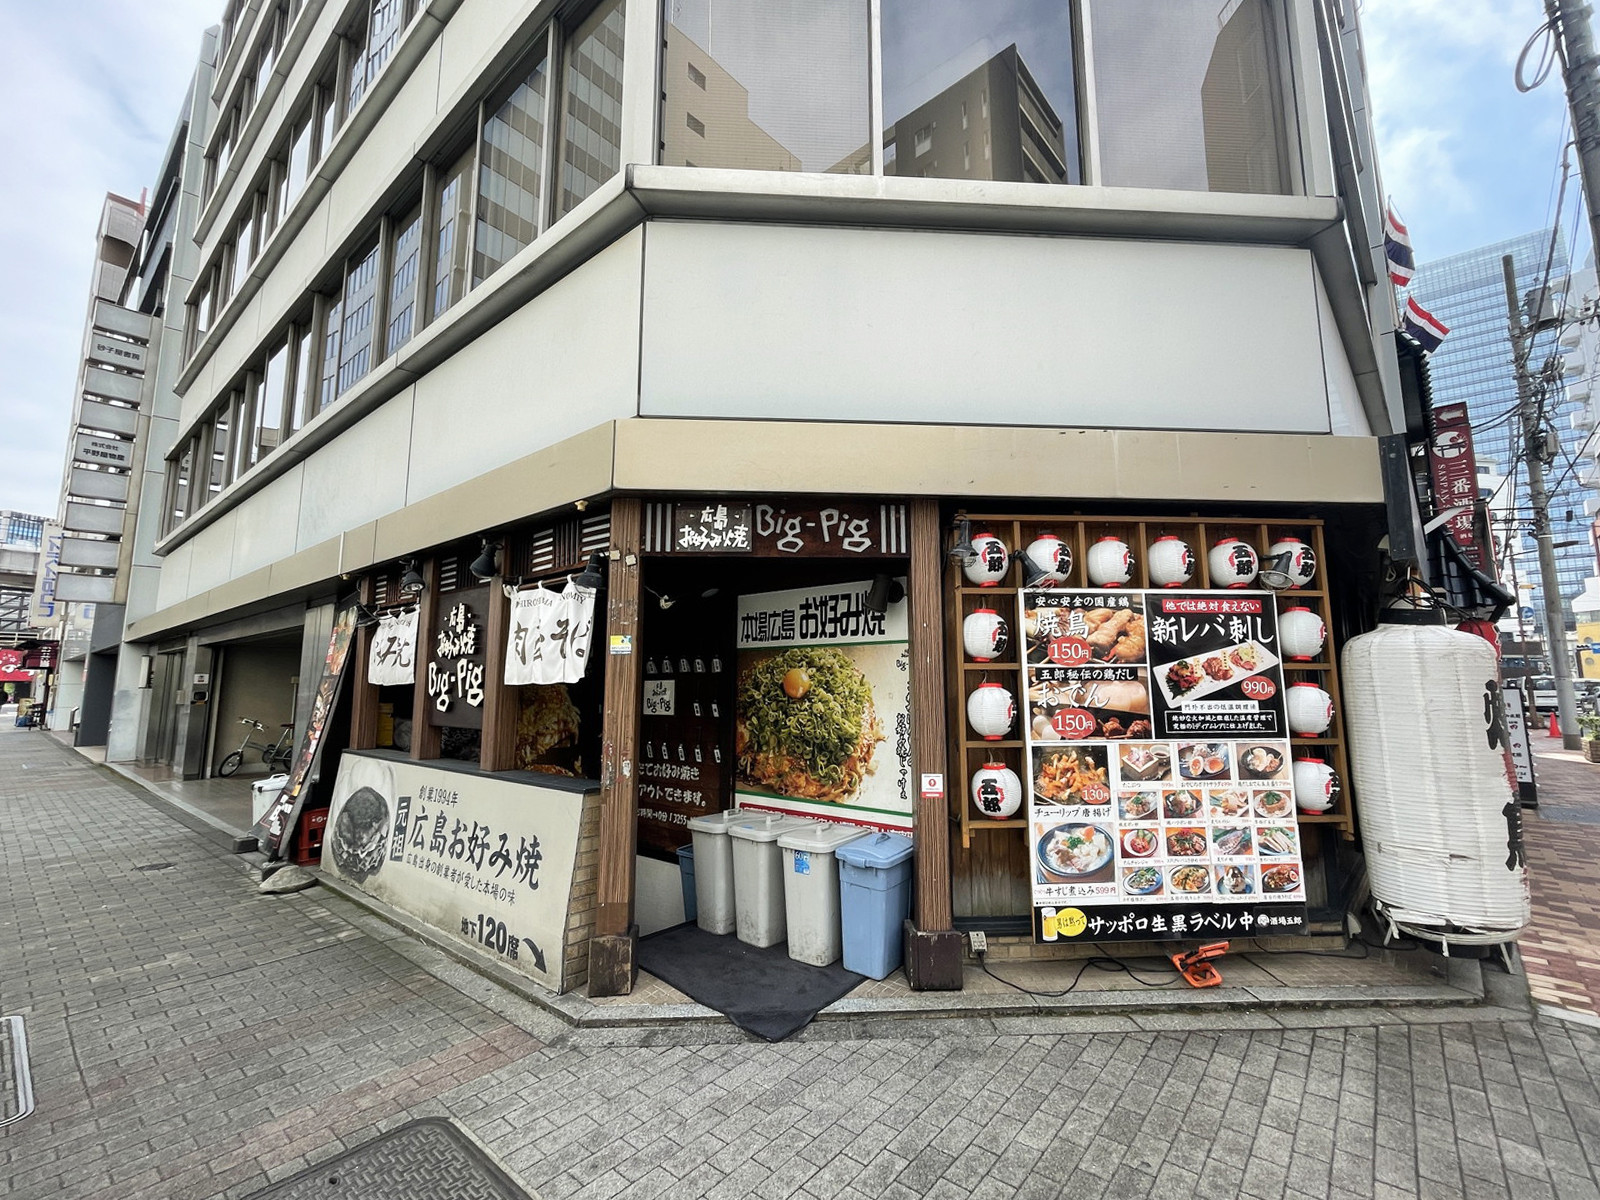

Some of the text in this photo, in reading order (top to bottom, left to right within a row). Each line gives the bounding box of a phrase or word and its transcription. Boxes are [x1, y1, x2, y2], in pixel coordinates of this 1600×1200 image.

[700, 505, 727, 531] 広島
[756, 504, 872, 553] Big-Pig
[679, 524, 748, 550] お好み焼
[985, 541, 1004, 573] 五郎
[1232, 545, 1254, 576] 五郎
[1035, 595, 1130, 607] 安心安全の国産鶏
[1165, 600, 1260, 613] 他では絶対食えない
[449, 602, 465, 634] 広島
[1033, 610, 1089, 639] 焼鳥
[1151, 614, 1275, 646] 新レバ刺し
[428, 658, 484, 712] Big-Pig
[1040, 668, 1135, 680] 五郎秘伝の鶏だし
[1243, 680, 1275, 695] 990円
[1037, 682, 1110, 708] おでん
[419, 785, 459, 808] 創業1994年
[981, 778, 1002, 813] 五郎
[1081, 789, 1110, 801] 130円
[1034, 807, 1112, 819] チューリップ唐揚げ
[393, 802, 409, 858] 元祖
[407, 805, 543, 890] 広島お好み焼
[406, 853, 516, 906] 広島出身の創業者が愛した本場の味
[1088, 909, 1255, 935] サッポロ生黒ラベル中
[461, 914, 520, 960] 地下120席
